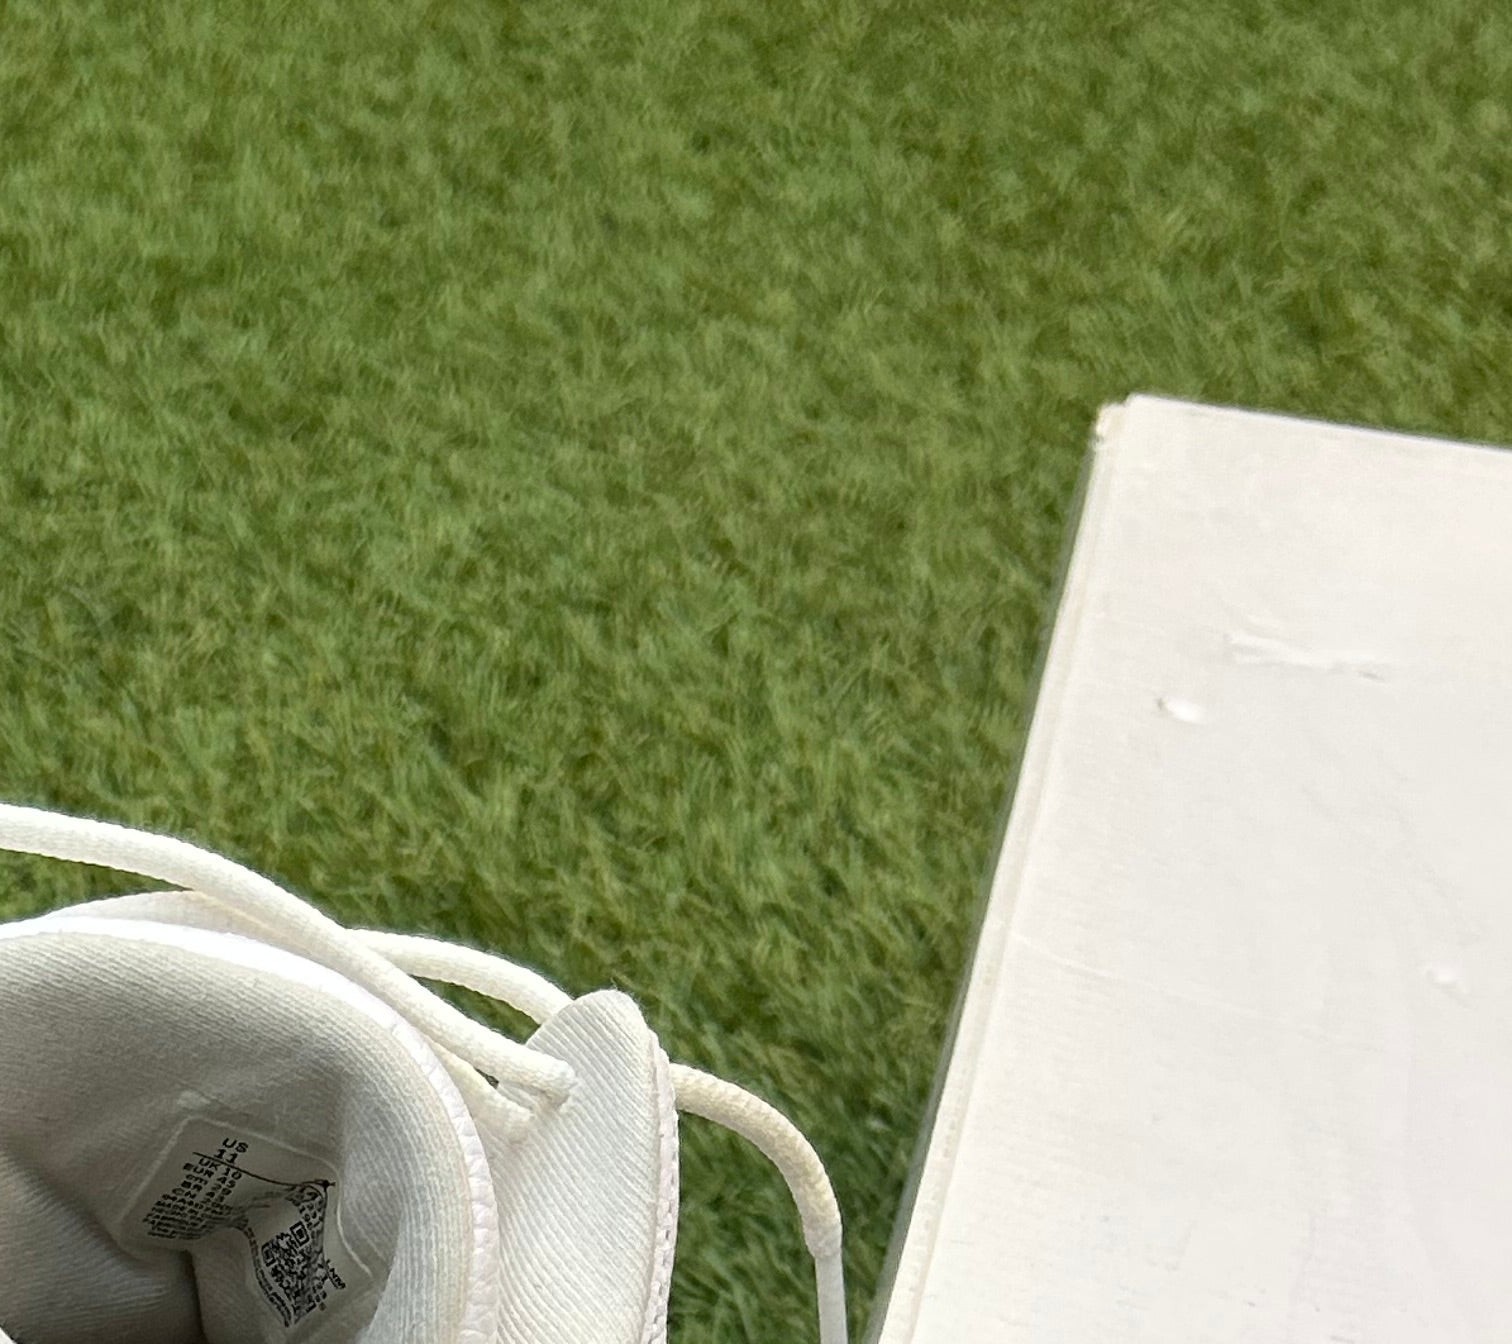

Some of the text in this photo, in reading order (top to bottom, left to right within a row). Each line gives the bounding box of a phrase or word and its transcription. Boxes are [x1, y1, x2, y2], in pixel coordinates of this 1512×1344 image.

[223, 1137, 249, 1153] US
[199, 1157, 221, 1172] UK
[213, 1148, 239, 1166] 11
[183, 1162, 215, 1179] EUR
